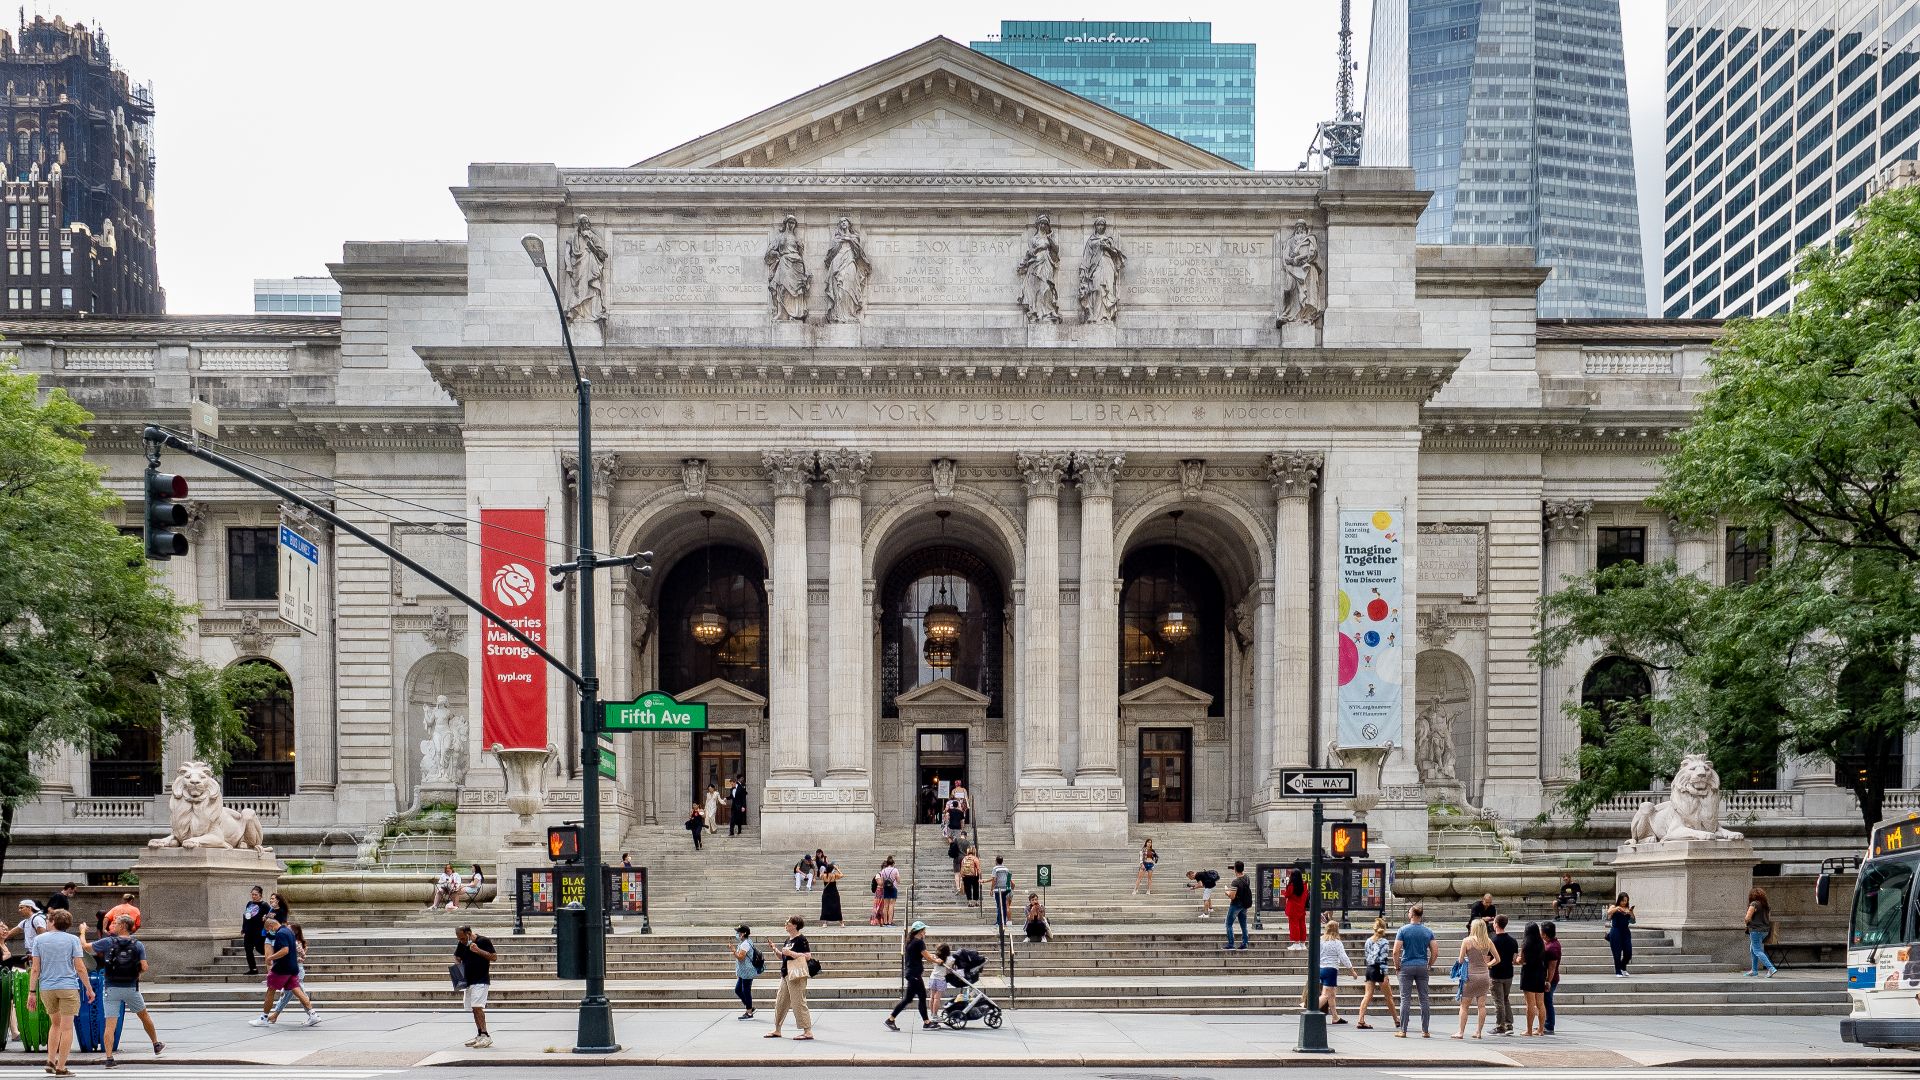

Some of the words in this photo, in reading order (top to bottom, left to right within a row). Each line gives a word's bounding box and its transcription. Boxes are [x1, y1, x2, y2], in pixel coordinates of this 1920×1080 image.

[1064, 31, 1150, 44] salesforce
[623, 239, 647, 252] THE
[656, 239, 697, 252] ASTOR
[703, 239, 760, 252] LIBRARY
[876, 240, 901, 253] THE
[908, 240, 952, 253] LENOX
[960, 240, 1014, 253] LIBRARY
[1129, 241, 1154, 254] THE
[1165, 241, 1213, 254] TILDEN
[1223, 241, 1266, 254] TRUST
[639, 266, 666, 276] JOHN
[671, 266, 704, 276] JACOB
[711, 266, 742, 275] ASTOR
[906, 266, 940, 276] JAMES
[949, 266, 983, 276] LENOX
[1143, 267, 1180, 277] SAMUEL
[1184, 268, 1214, 277] JONES
[1219, 268, 1251, 277] TILDEN
[872, 285, 924, 294] LITERATURE
[570, 406, 663, 420] MCCCXCV
[716, 403, 769, 421] THE
[787, 403, 849, 421] NEW
[872, 403, 937, 421] YORK
[958, 404, 1047, 421] PUBLIC
[1070, 404, 1173, 421] LIBRARY
[1344, 545, 1392, 557] Imagine
[1344, 554, 1398, 567] Together
[1418, 560, 1445, 569] ARETH
[1360, 576, 1397, 584] Discover?
[487, 644, 540, 659] Stronge
[497, 671, 532, 683] nypl.org
[621, 709, 656, 725] Fifth
[661, 709, 691, 725] Ave
[1294, 779, 1314, 788] ONE
[1322, 779, 1344, 788] WAY
[1887, 826, 1902, 851] M4
[562, 877, 586, 886] BLAC
